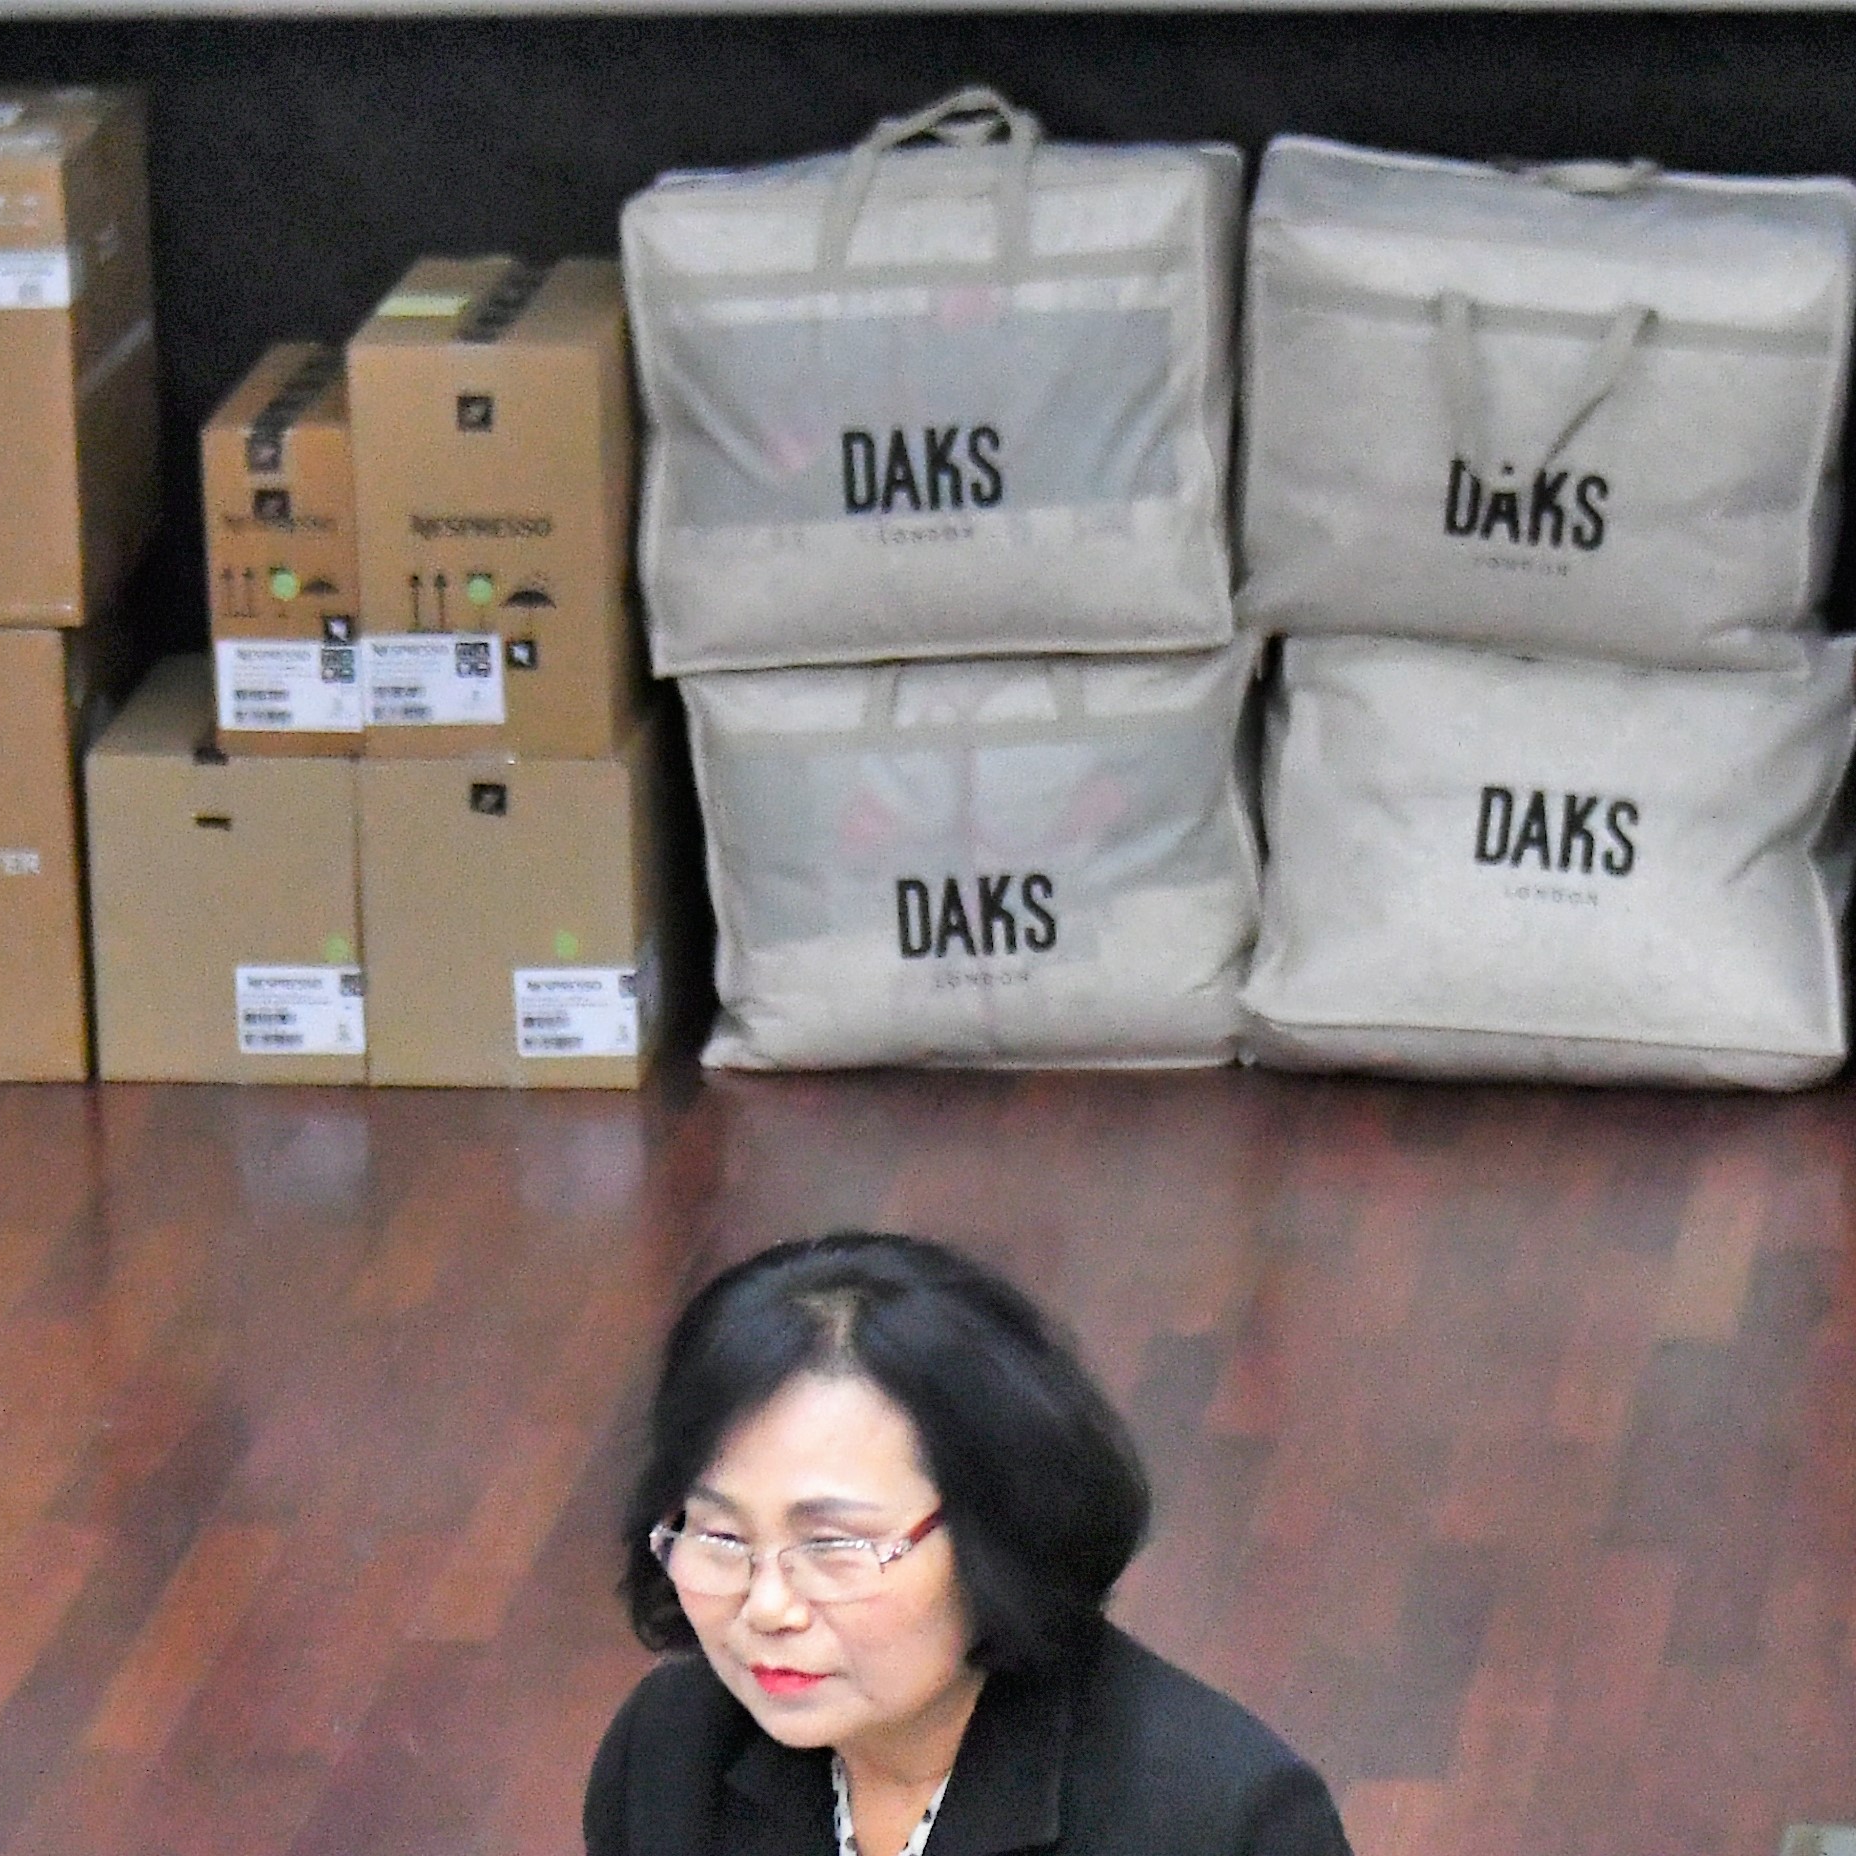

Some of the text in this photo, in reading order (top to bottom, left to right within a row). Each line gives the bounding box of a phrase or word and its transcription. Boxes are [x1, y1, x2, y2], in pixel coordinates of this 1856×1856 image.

[843, 426, 1004, 514] DAKS
[1444, 458, 1609, 552] DAKS
[1474, 786, 1639, 878] DAKS
[896, 873, 1057, 959] DAKS
